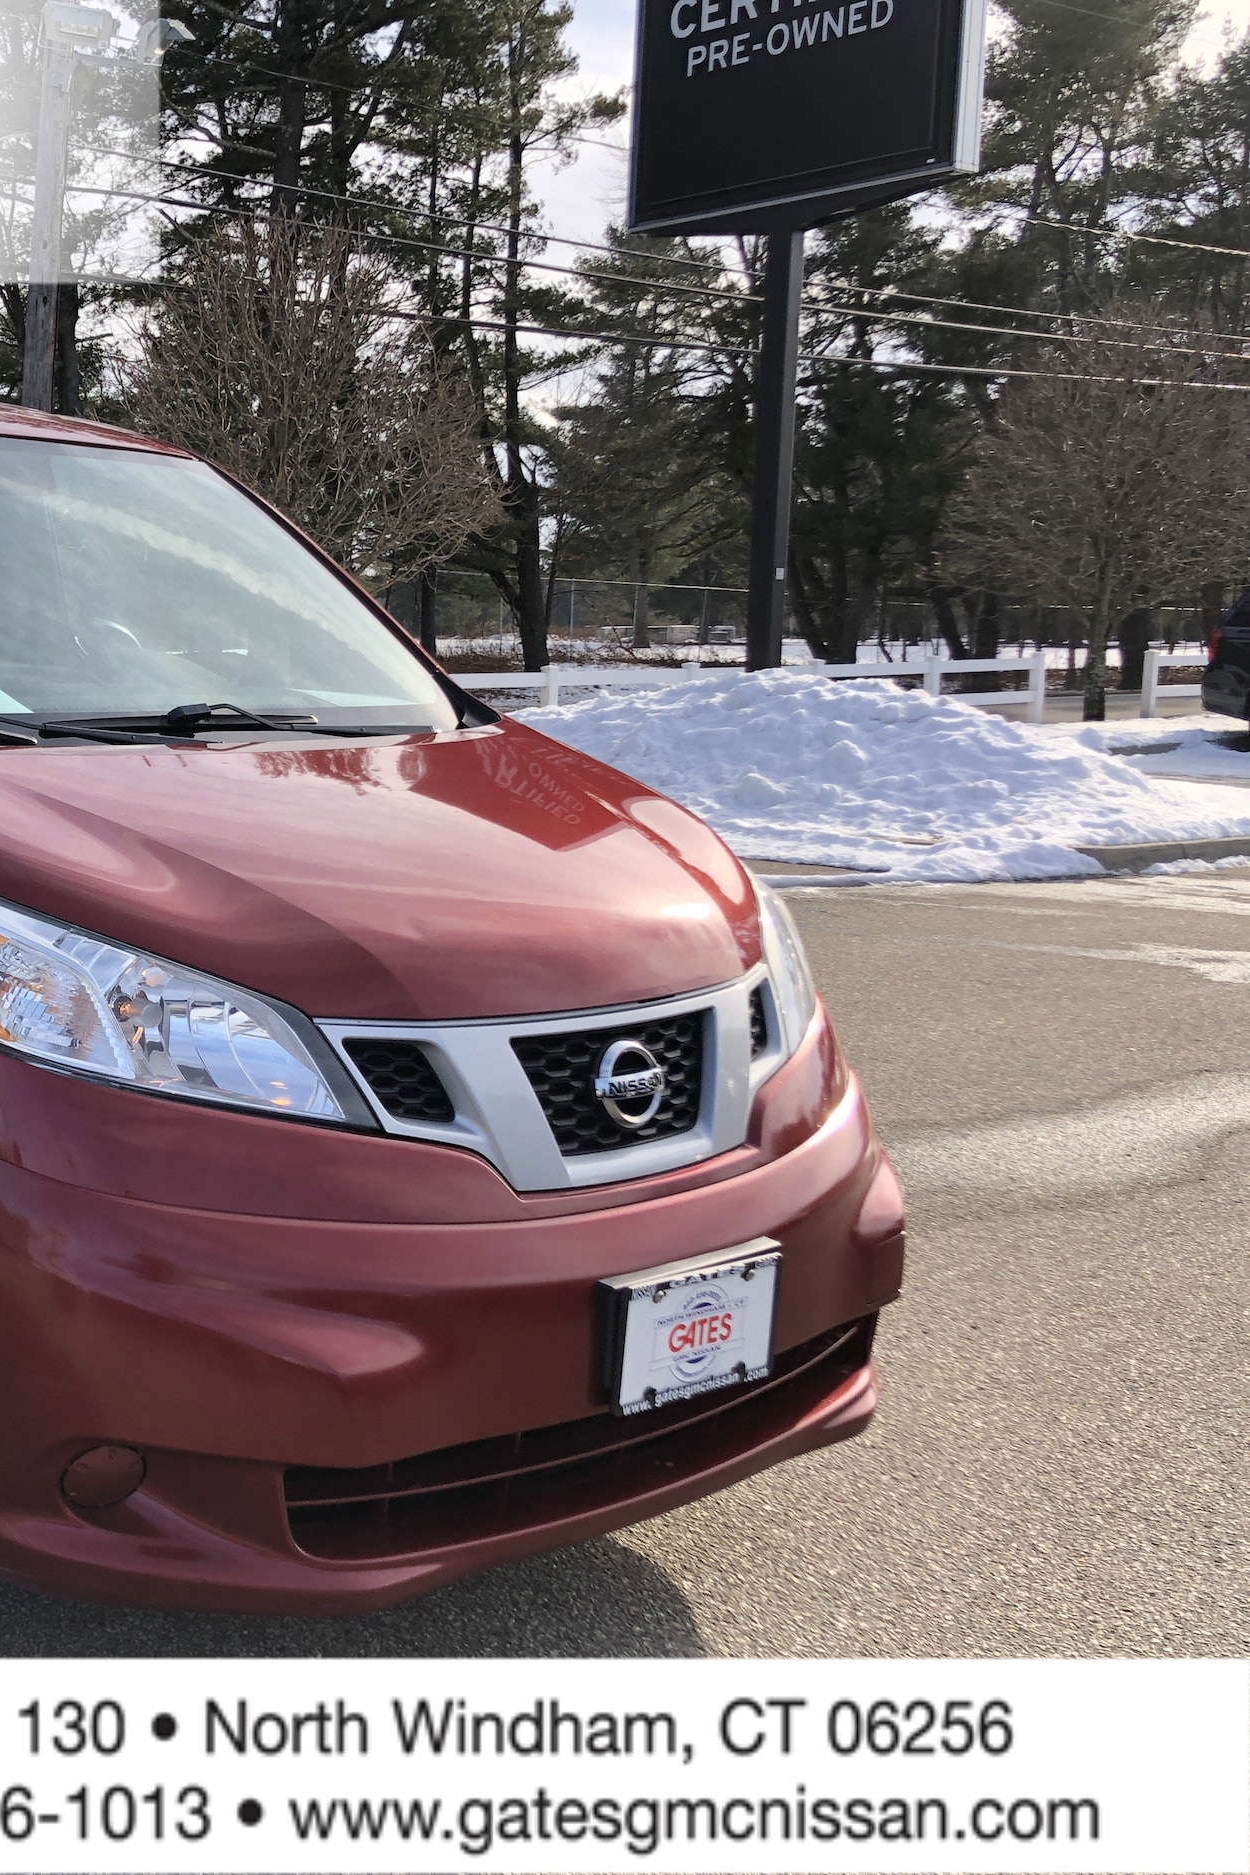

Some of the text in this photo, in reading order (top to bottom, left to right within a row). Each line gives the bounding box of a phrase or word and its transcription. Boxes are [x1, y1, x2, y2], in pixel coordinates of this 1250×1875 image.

[670, 0, 819, 39] CER
[686, 0, 895, 77] PRE-OWNED
[607, 1072, 663, 1097] NISSAN
[668, 1312, 733, 1353] GATES
